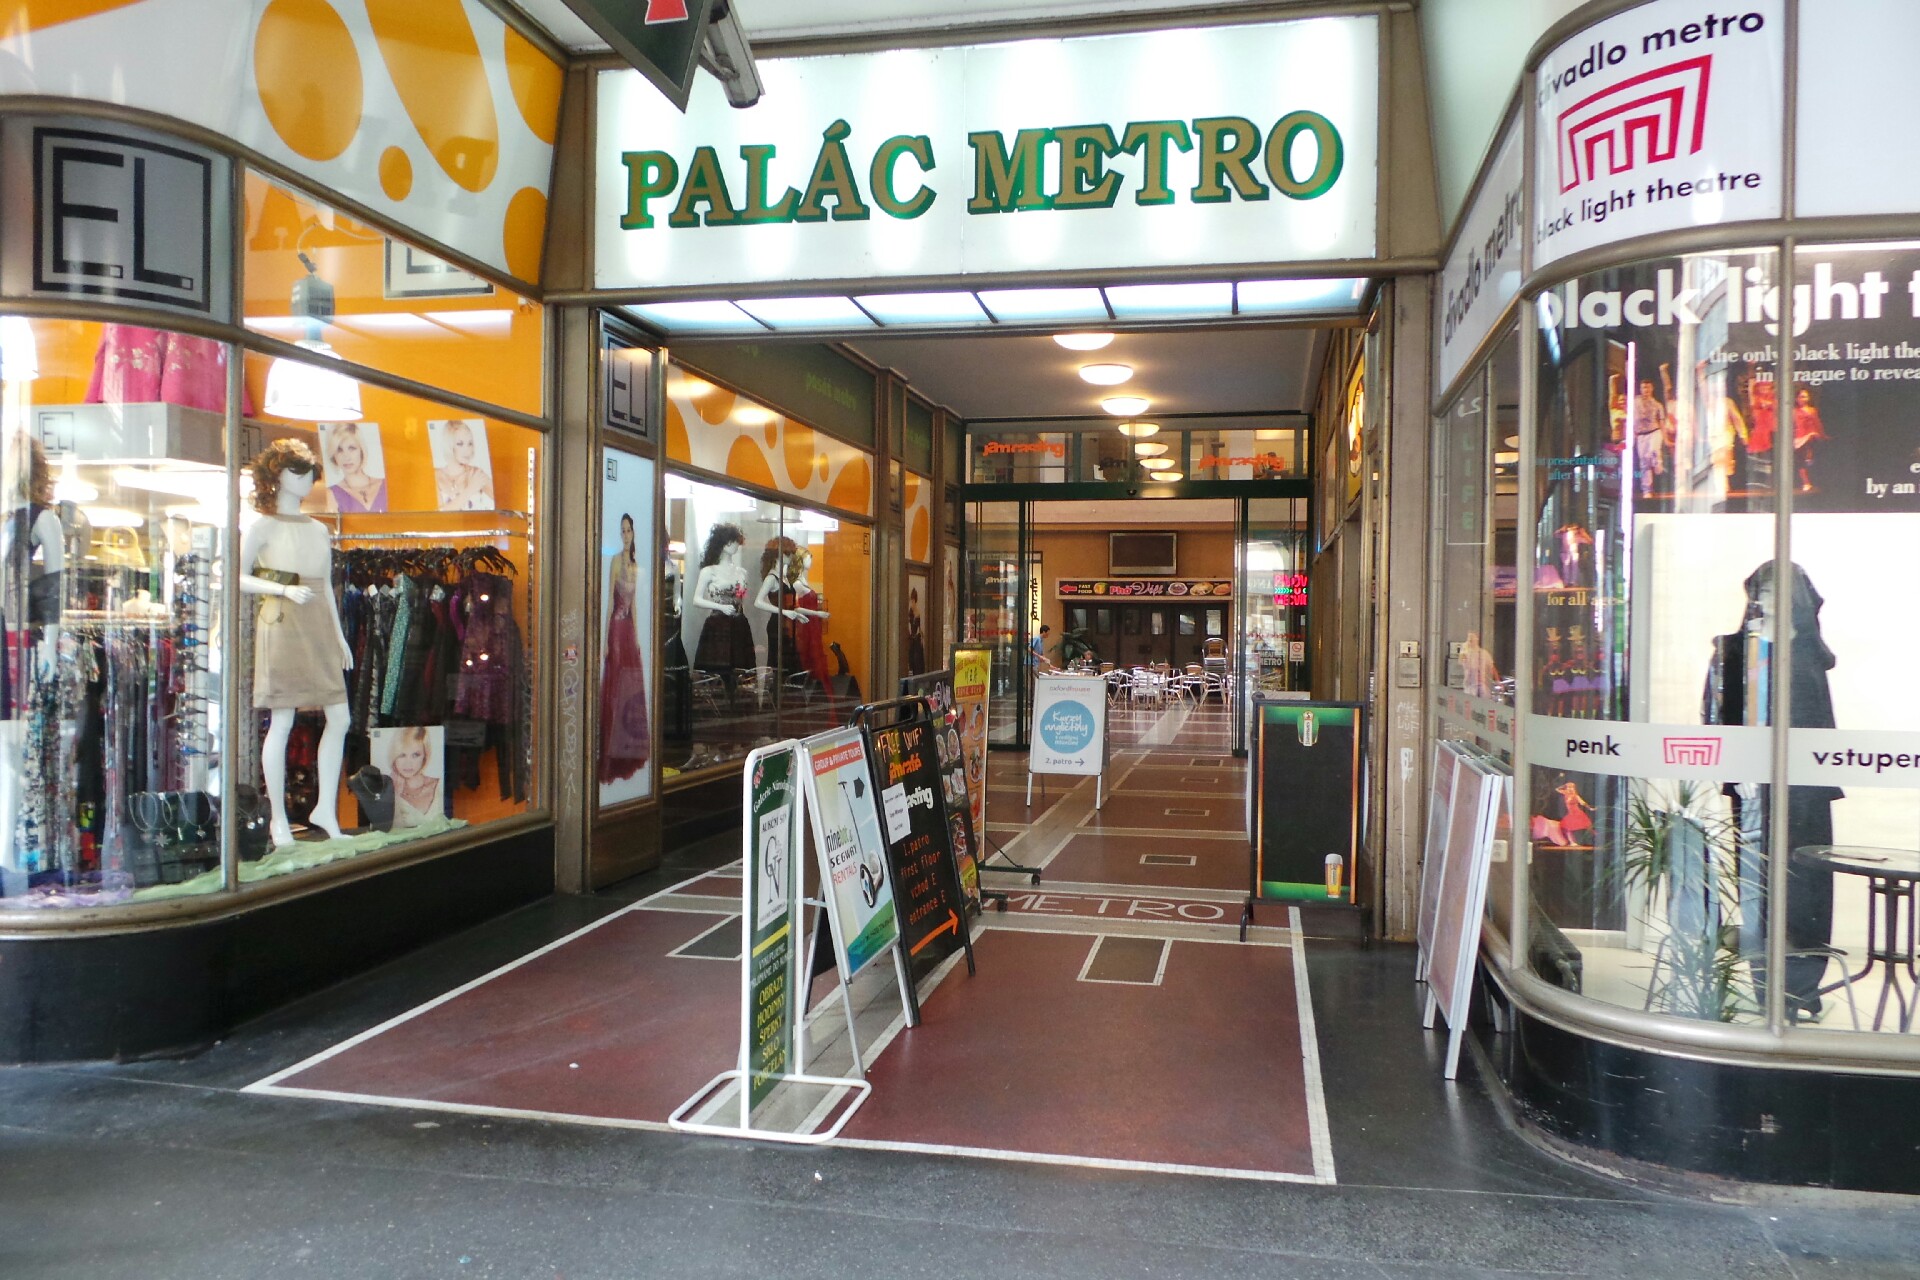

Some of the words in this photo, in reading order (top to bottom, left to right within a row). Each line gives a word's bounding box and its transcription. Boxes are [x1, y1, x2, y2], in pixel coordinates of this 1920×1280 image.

[1538, 41, 1627, 109] divadlo
[1642, 12, 1764, 54] metro
[621, 118, 936, 229] PALÁC
[967, 110, 1344, 213] METRO
[1581, 189, 1635, 223] light
[1646, 172, 1761, 204] theatre
[53, 146, 194, 291] EL
[1727, 262, 1890, 337] light
[1709, 346, 1739, 363] the
[1742, 345, 1779, 365] only
[1845, 342, 1890, 364] light
[1755, 366, 1774, 382] in
[1793, 369, 1846, 386] rague
[1850, 367, 1869, 381] to
[1866, 477, 1889, 498] by
[1892, 483, 1916, 494] an
[1547, 592, 1565, 606] for
[1568, 591, 1587, 606] all
[815, 757, 829, 771] GROUP
[832, 750, 849, 764] PRIVATE
[847, 746, 861, 758] TOURS
[1566, 735, 1621, 757] penk
[830, 844, 857, 868] SEGWAY
[832, 861, 857, 886] RENTALS
[983, 893, 1225, 920] METRO
[759, 973, 784, 1006] OBRAZY
